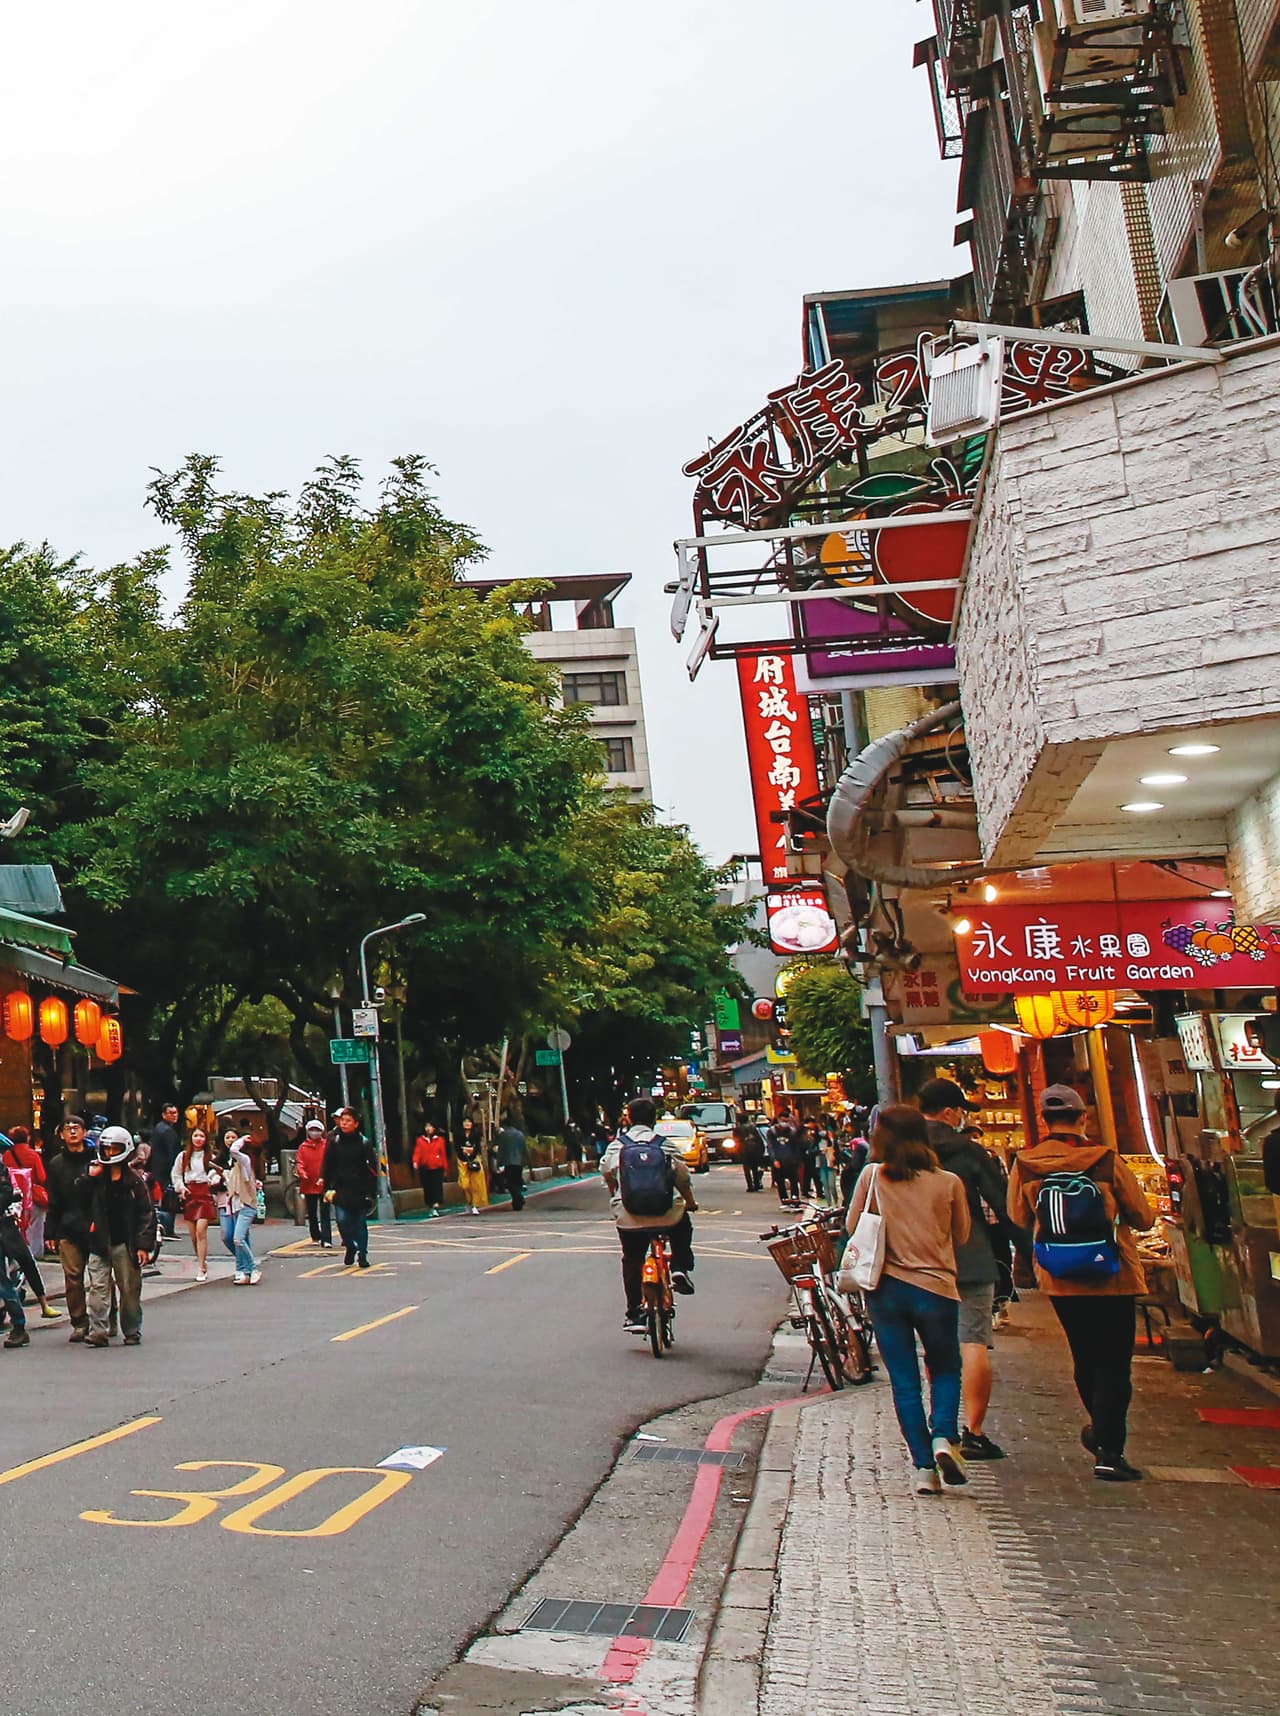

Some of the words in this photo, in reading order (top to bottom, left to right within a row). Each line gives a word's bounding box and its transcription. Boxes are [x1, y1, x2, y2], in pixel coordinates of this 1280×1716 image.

[970, 917, 1151, 959] 永康水果園
[967, 964, 1057, 985] YongKang
[1067, 965, 1116, 982] Fruit
[1126, 963, 1195, 981] Garden
[78, 1460, 413, 1537] 30
